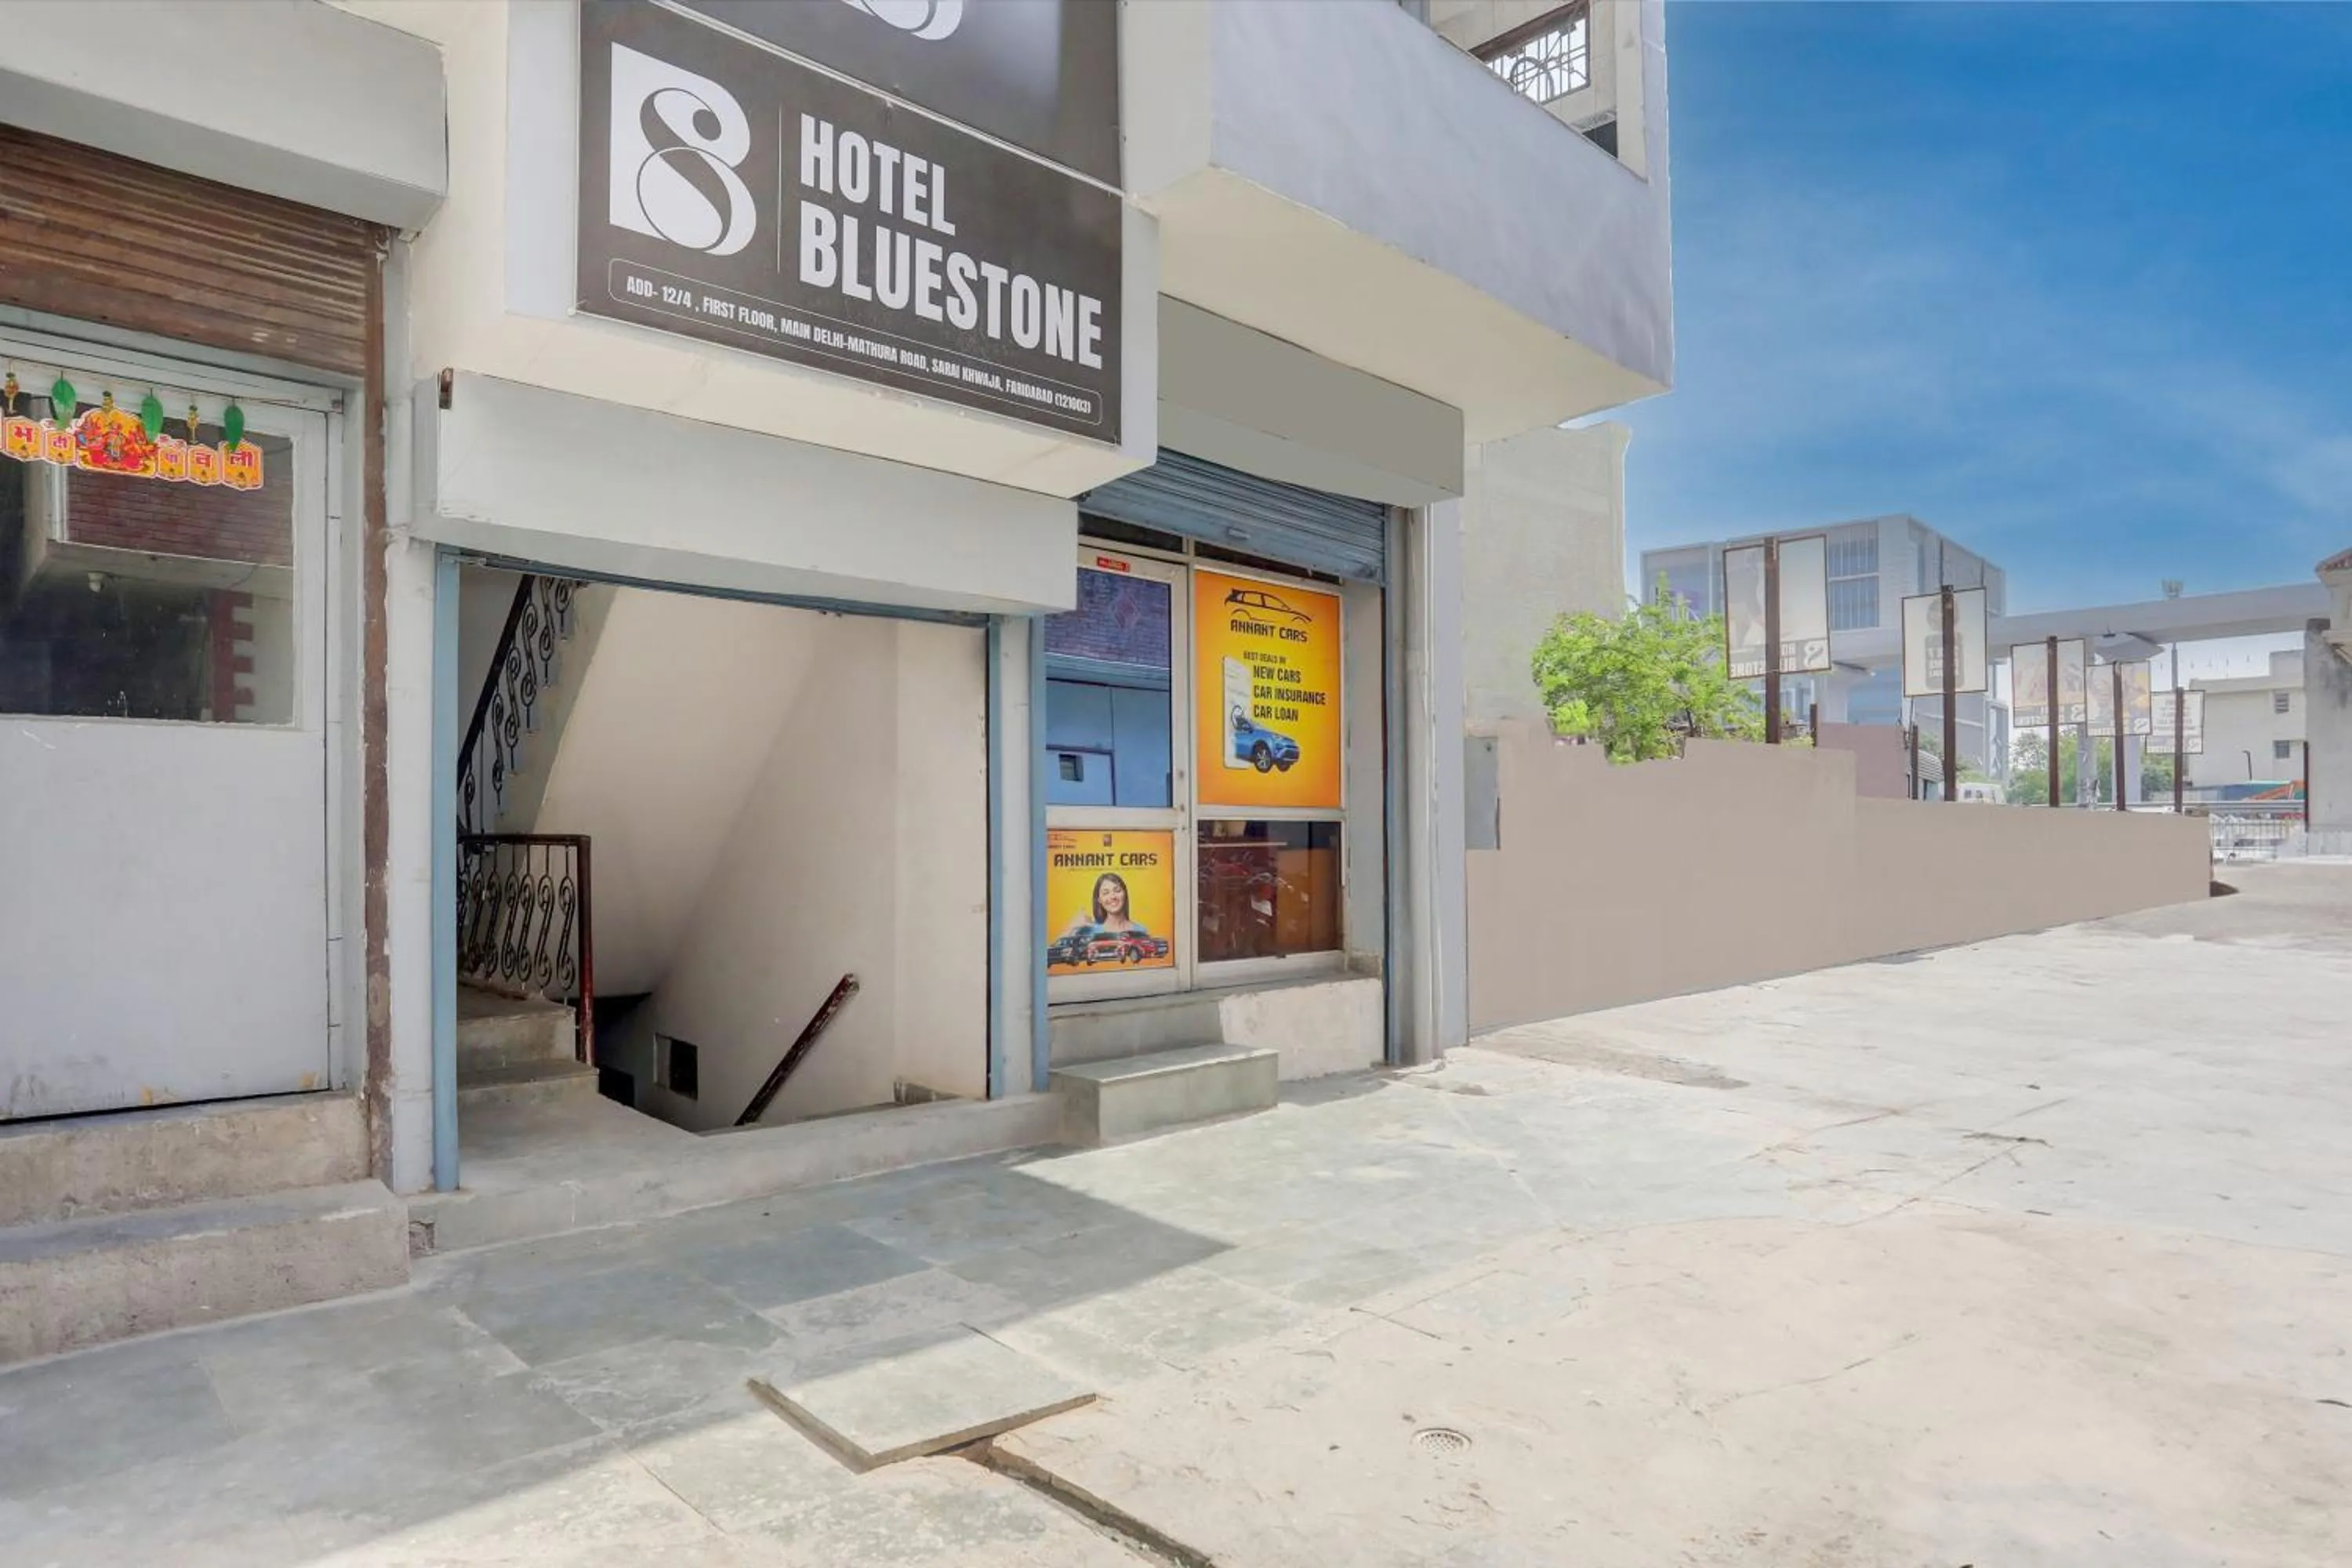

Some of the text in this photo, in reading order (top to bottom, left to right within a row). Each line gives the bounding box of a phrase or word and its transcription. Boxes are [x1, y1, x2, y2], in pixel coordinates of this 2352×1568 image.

[800, 113, 956, 236] HOTEL
[799, 200, 1102, 370] BLUESTONE
[662, 285, 691, 308] 12/4
[702, 296, 735, 320] FIRST
[739, 307, 778, 332] FLOOR,
[780, 318, 810, 339] MAIN
[900, 350, 929, 372] ROAD,
[931, 358, 960, 379] SARAI
[962, 366, 1004, 392] KHWAJA,
[1006, 379, 1053, 404] FARIDABAD
[1230, 619, 1308, 642] ANNANT CARS
[1254, 665, 1301, 684] NEW CARS
[1254, 685, 1326, 705] CAR INSURANCE
[1254, 705, 1299, 721] CAR LOAN
[1054, 853, 1158, 866] ANNANT CARS
